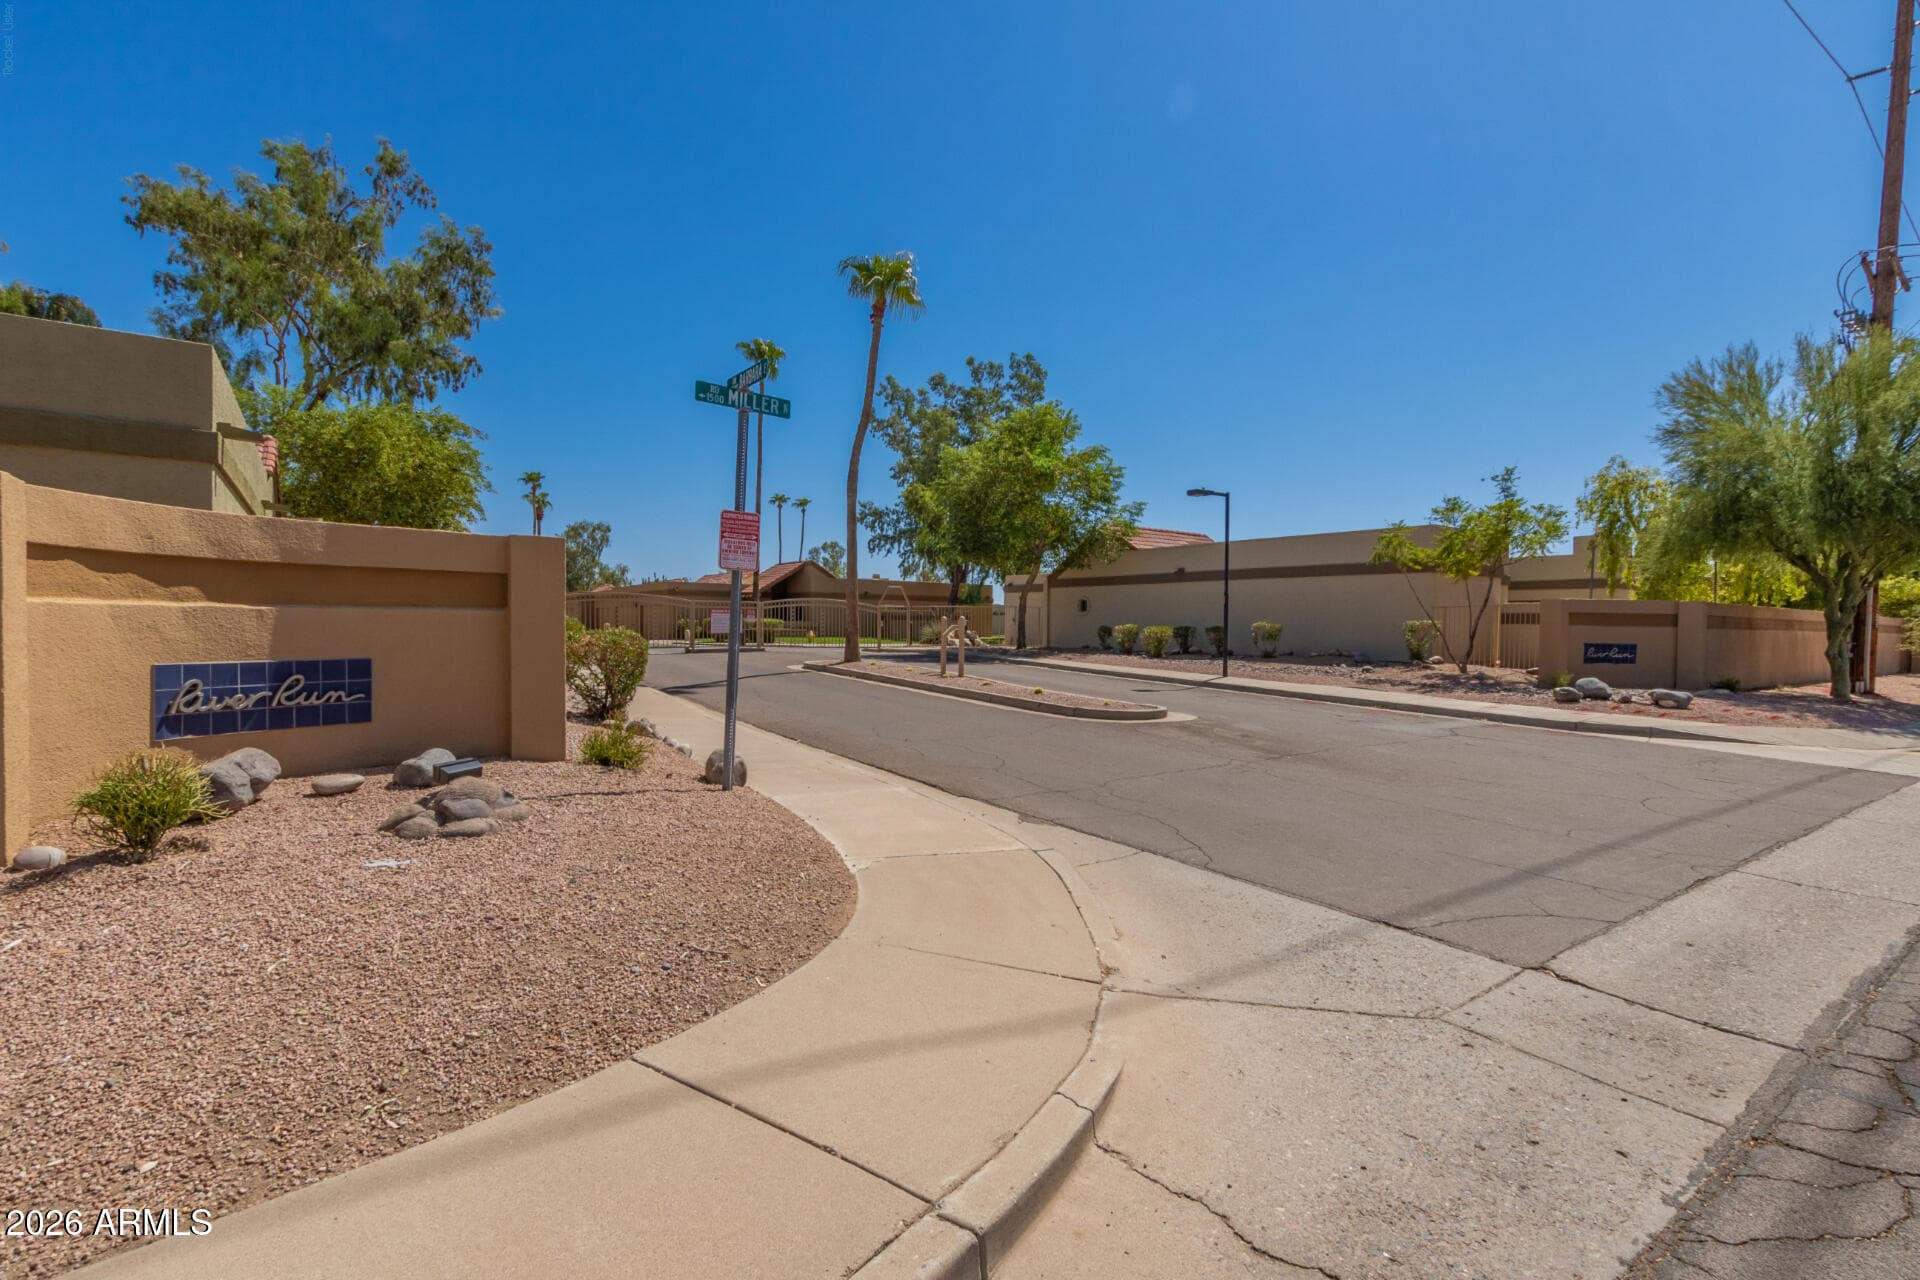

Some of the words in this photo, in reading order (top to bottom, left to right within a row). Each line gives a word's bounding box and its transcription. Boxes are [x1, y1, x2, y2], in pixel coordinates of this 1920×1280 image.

[707, 392, 724, 404] 1500
[728, 389, 779, 415] MILLER
[783, 403, 788, 414] N
[170, 678, 272, 715] River
[272, 674, 365, 707] Run
